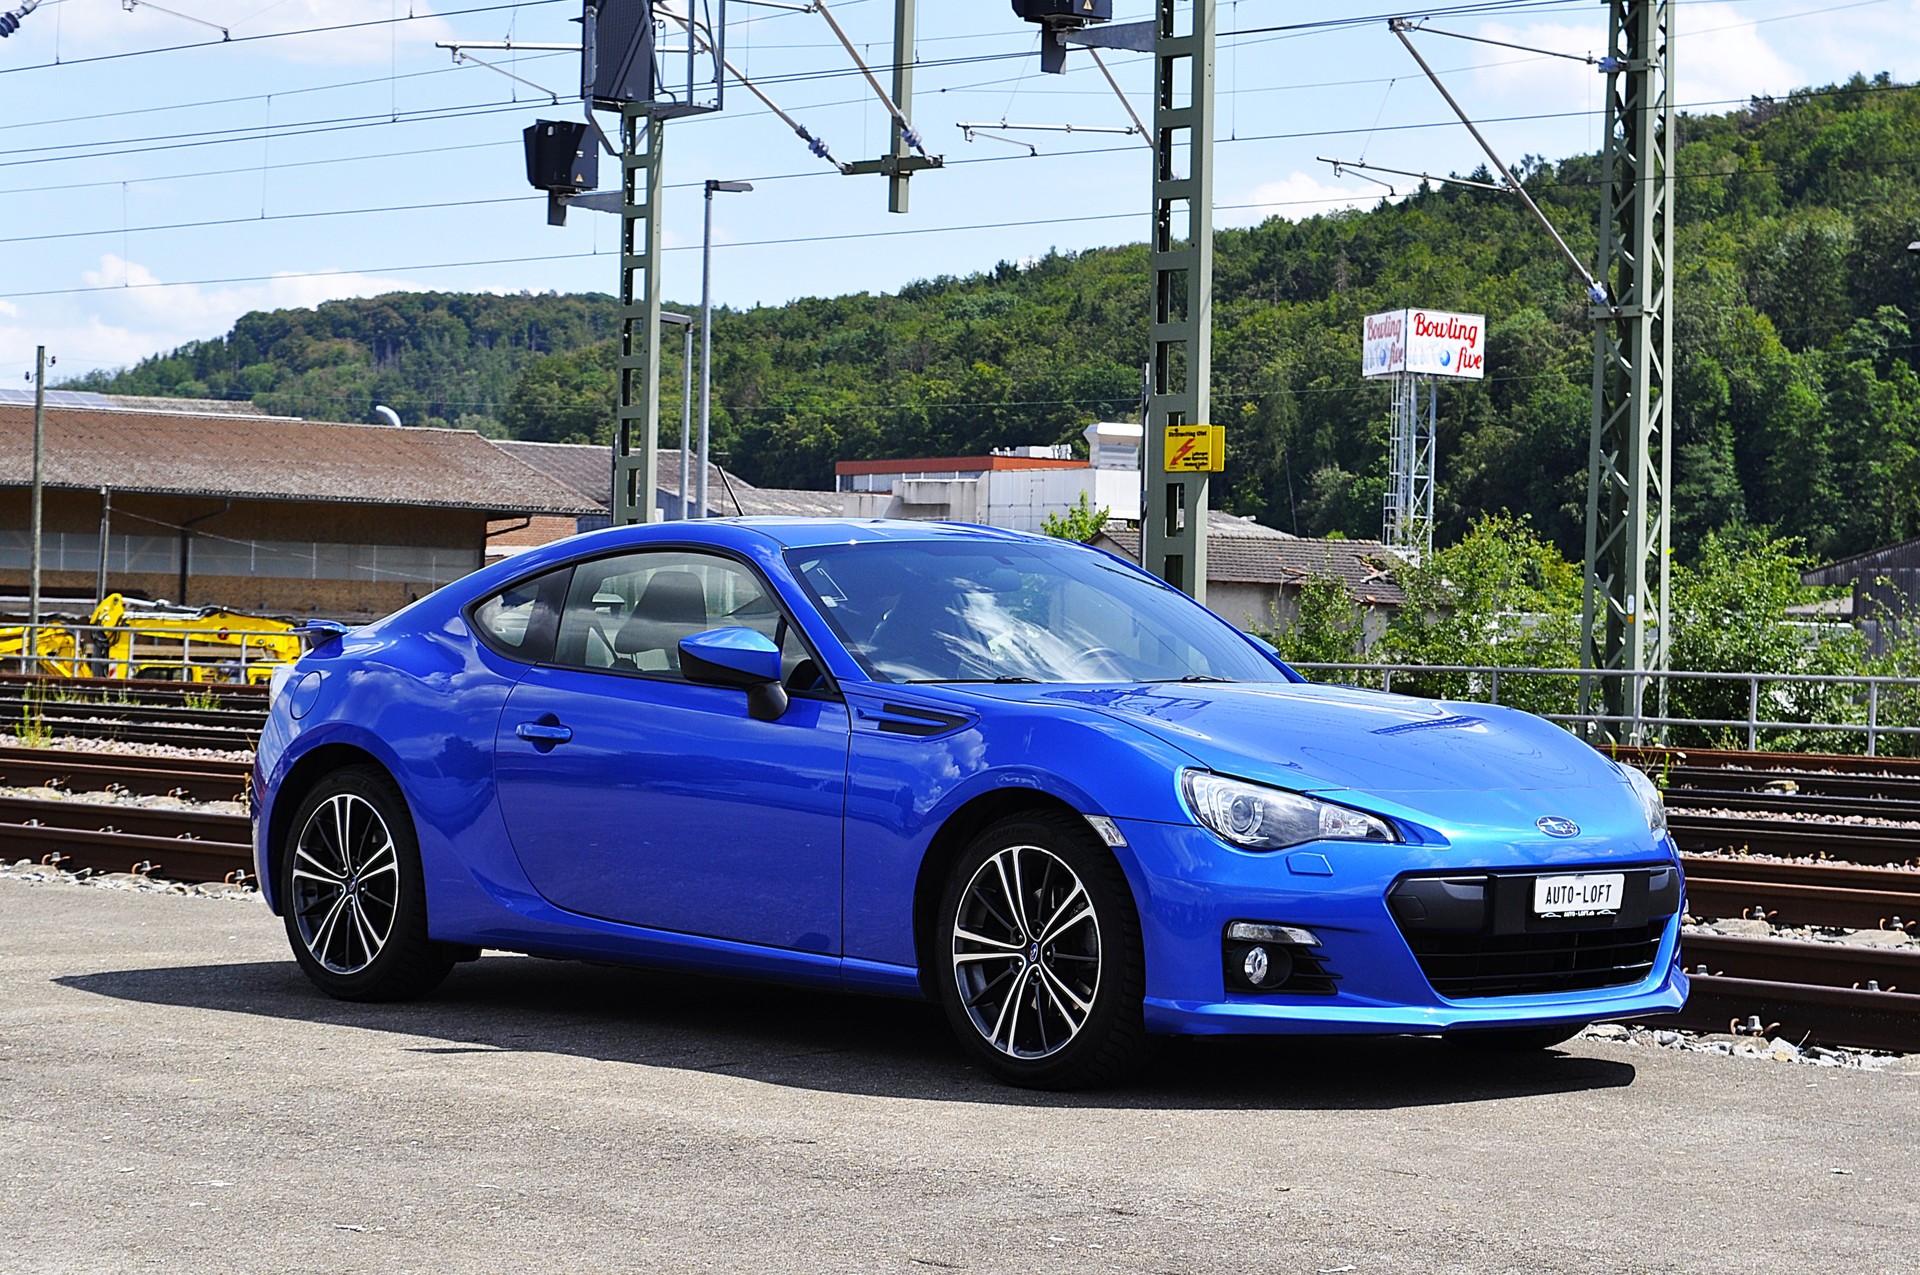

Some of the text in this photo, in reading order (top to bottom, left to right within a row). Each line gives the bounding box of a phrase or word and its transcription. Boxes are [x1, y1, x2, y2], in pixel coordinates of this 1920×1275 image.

[1366, 316, 1402, 342] Bowling
[1413, 312, 1478, 348] Bowling
[1387, 341, 1403, 371] five
[1454, 346, 1483, 373] five
[1545, 884, 1612, 904] AUTO-LOFT
